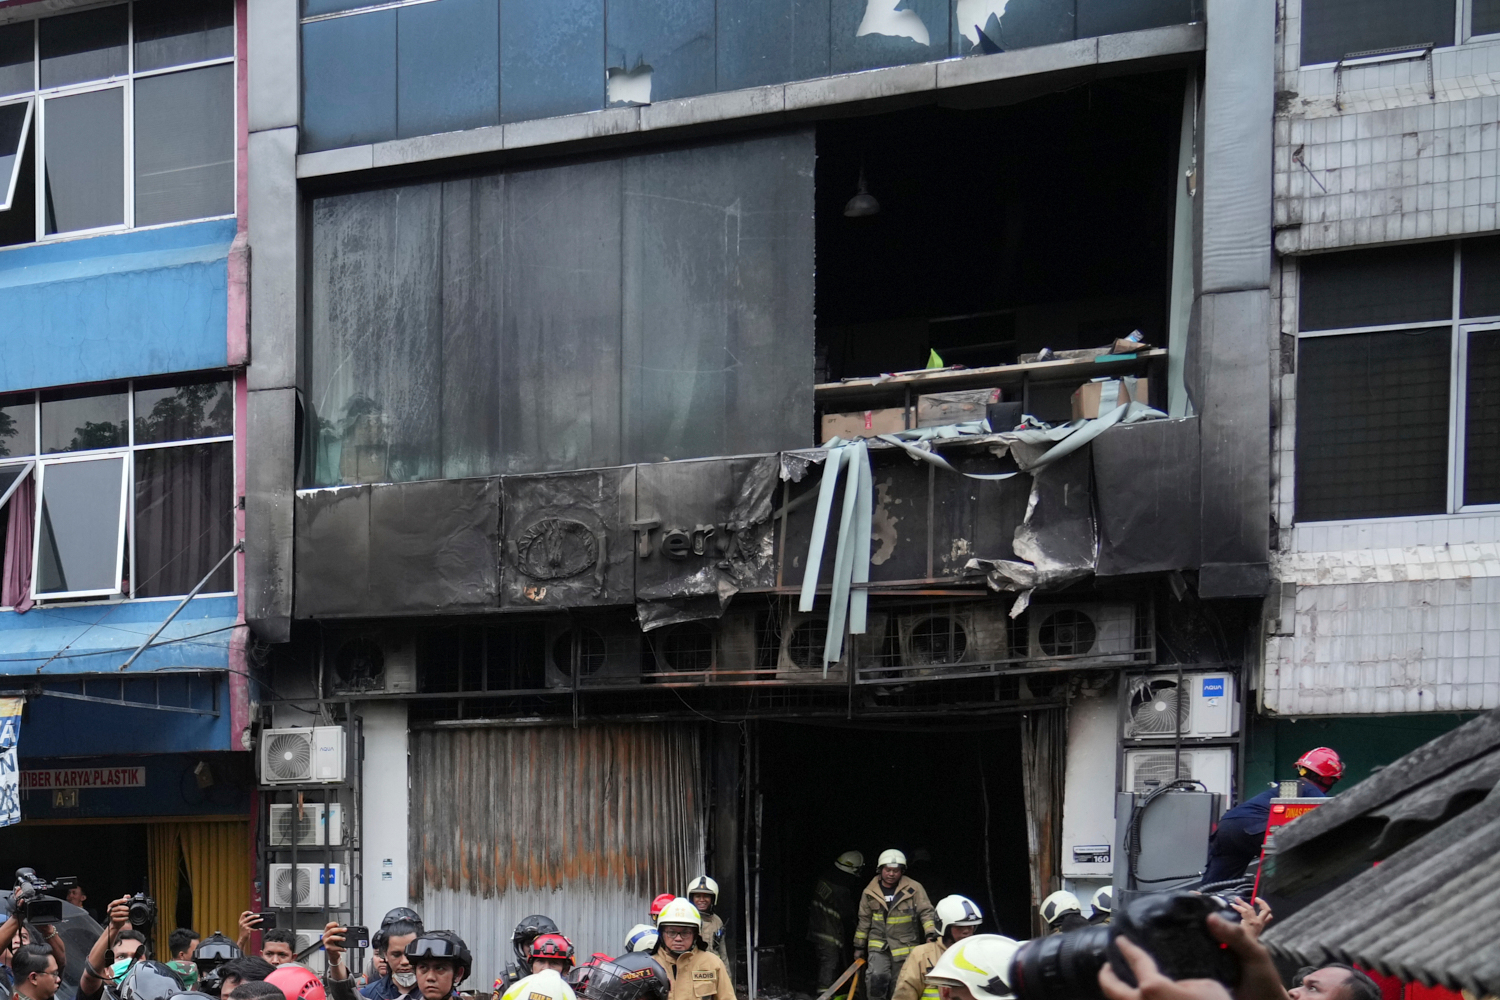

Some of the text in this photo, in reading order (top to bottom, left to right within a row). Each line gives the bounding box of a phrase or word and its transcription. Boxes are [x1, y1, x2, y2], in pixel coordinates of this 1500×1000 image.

[18, 769, 139, 788] UMBER KARYA PLASTIK
